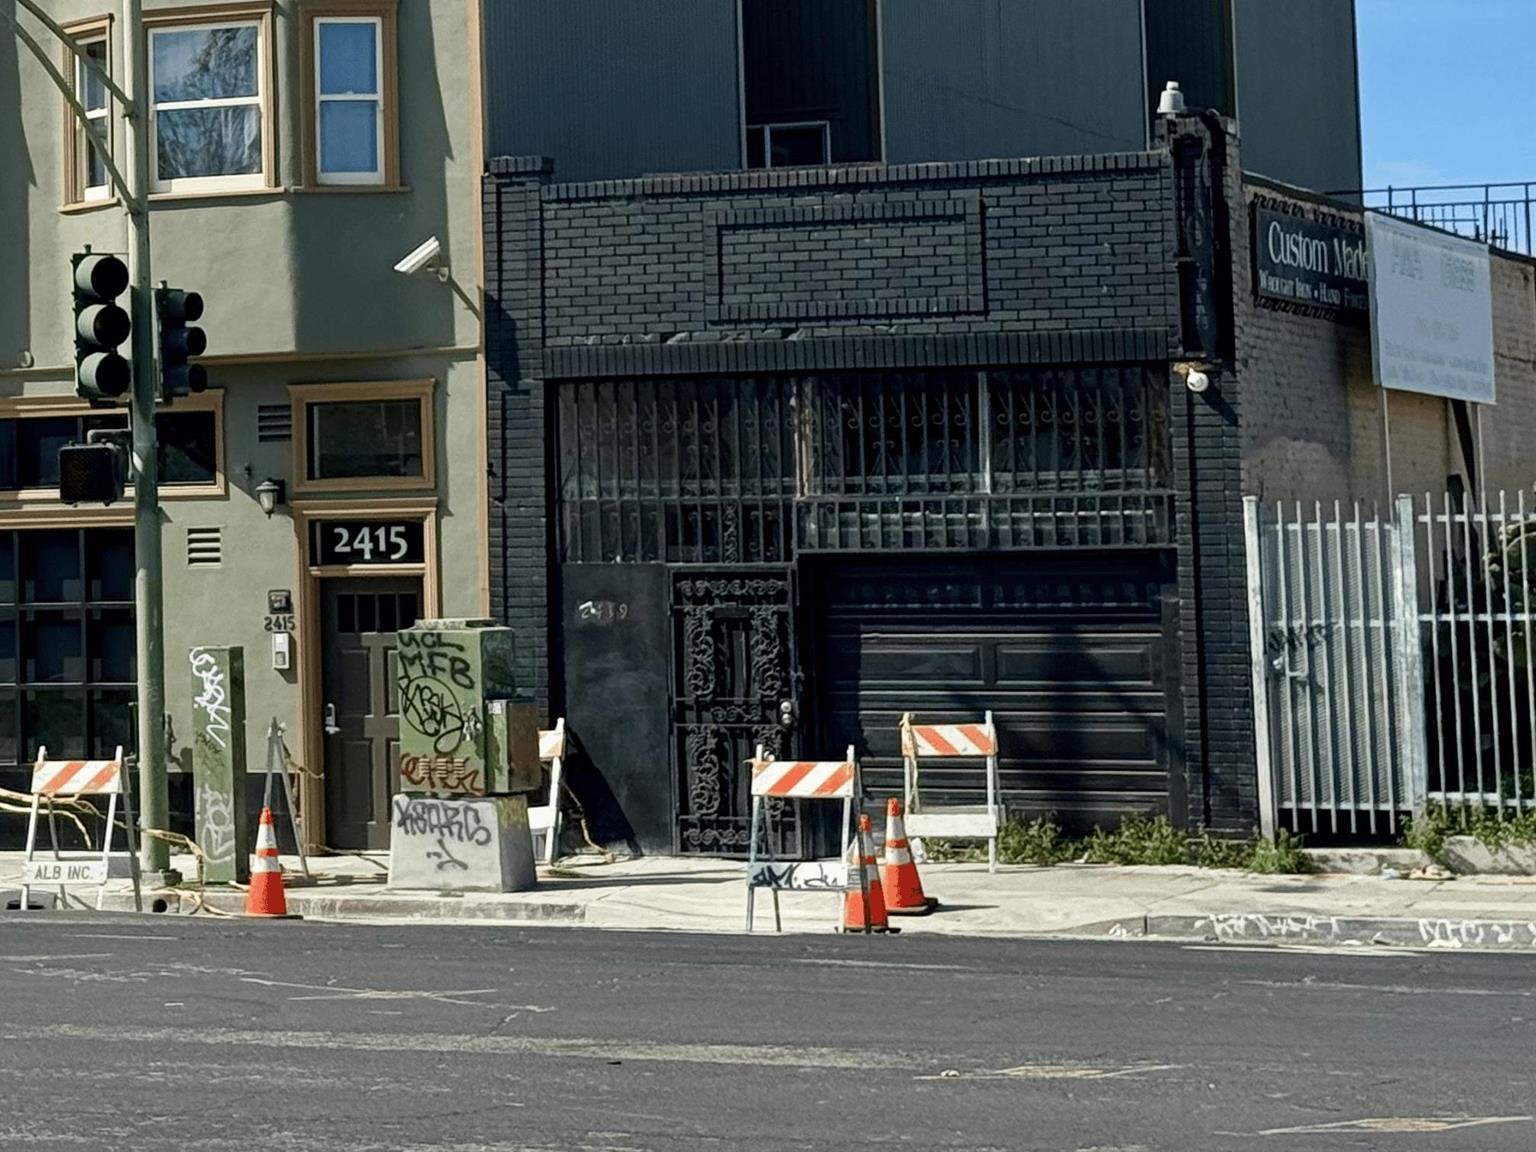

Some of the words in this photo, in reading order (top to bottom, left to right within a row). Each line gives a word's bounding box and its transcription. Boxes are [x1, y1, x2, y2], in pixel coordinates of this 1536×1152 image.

[1268, 221, 1328, 273] Custom
[334, 526, 408, 560] 2415
[264, 616, 296, 631] 2415
[34, 865, 61, 880] ALB
